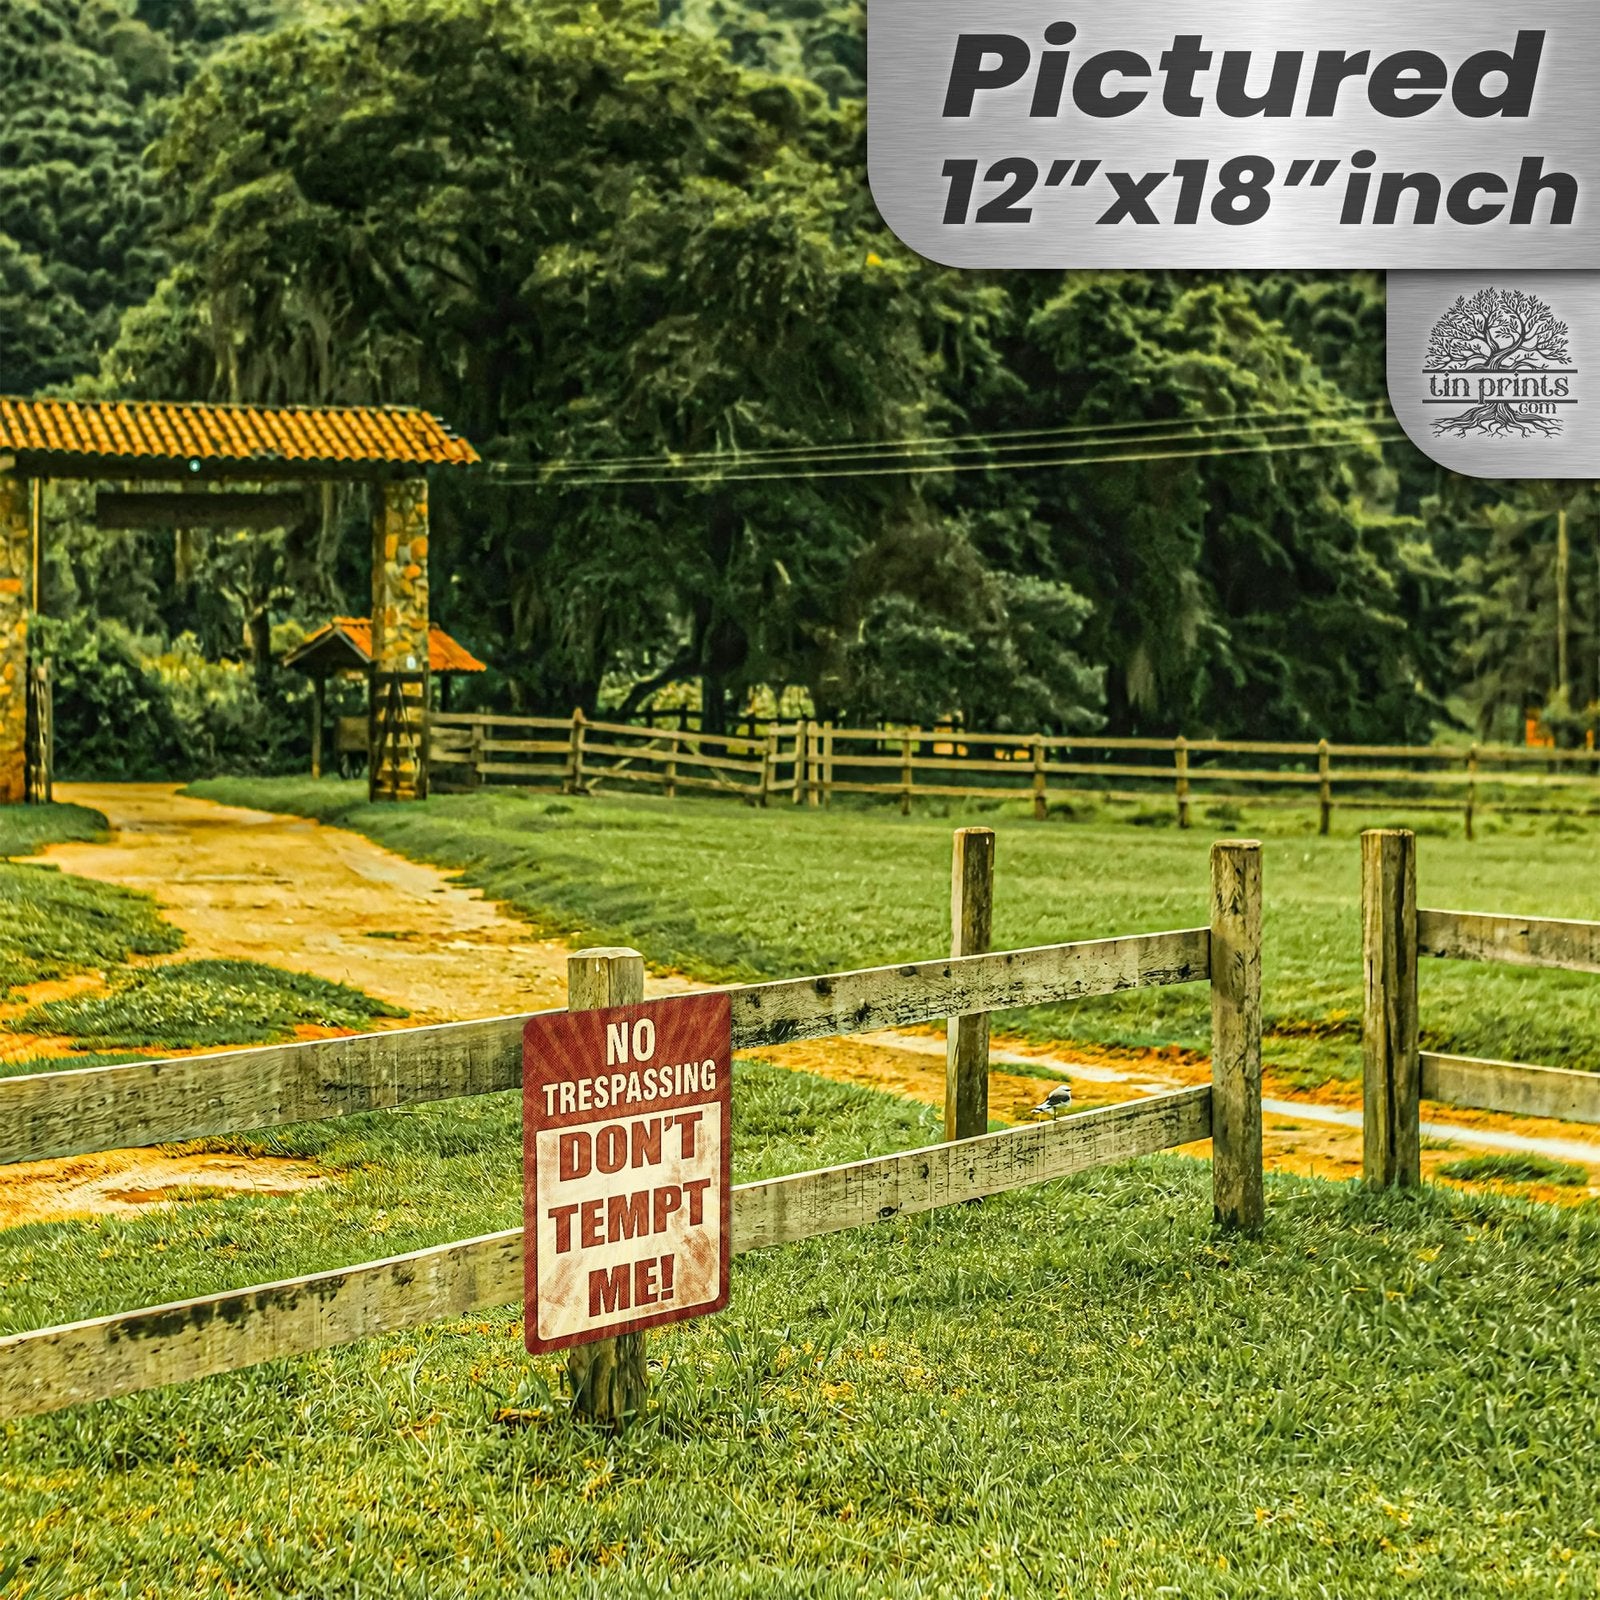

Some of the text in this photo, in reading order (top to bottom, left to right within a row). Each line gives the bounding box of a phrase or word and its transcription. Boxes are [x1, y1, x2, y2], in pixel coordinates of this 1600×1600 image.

[607, 1018, 655, 1064] NO
[542, 1059, 716, 1116] TRESPASSING
[559, 1111, 702, 1182] DON'T
[548, 1178, 710, 1254] TEMPT
[588, 1254, 675, 1318] ME!
